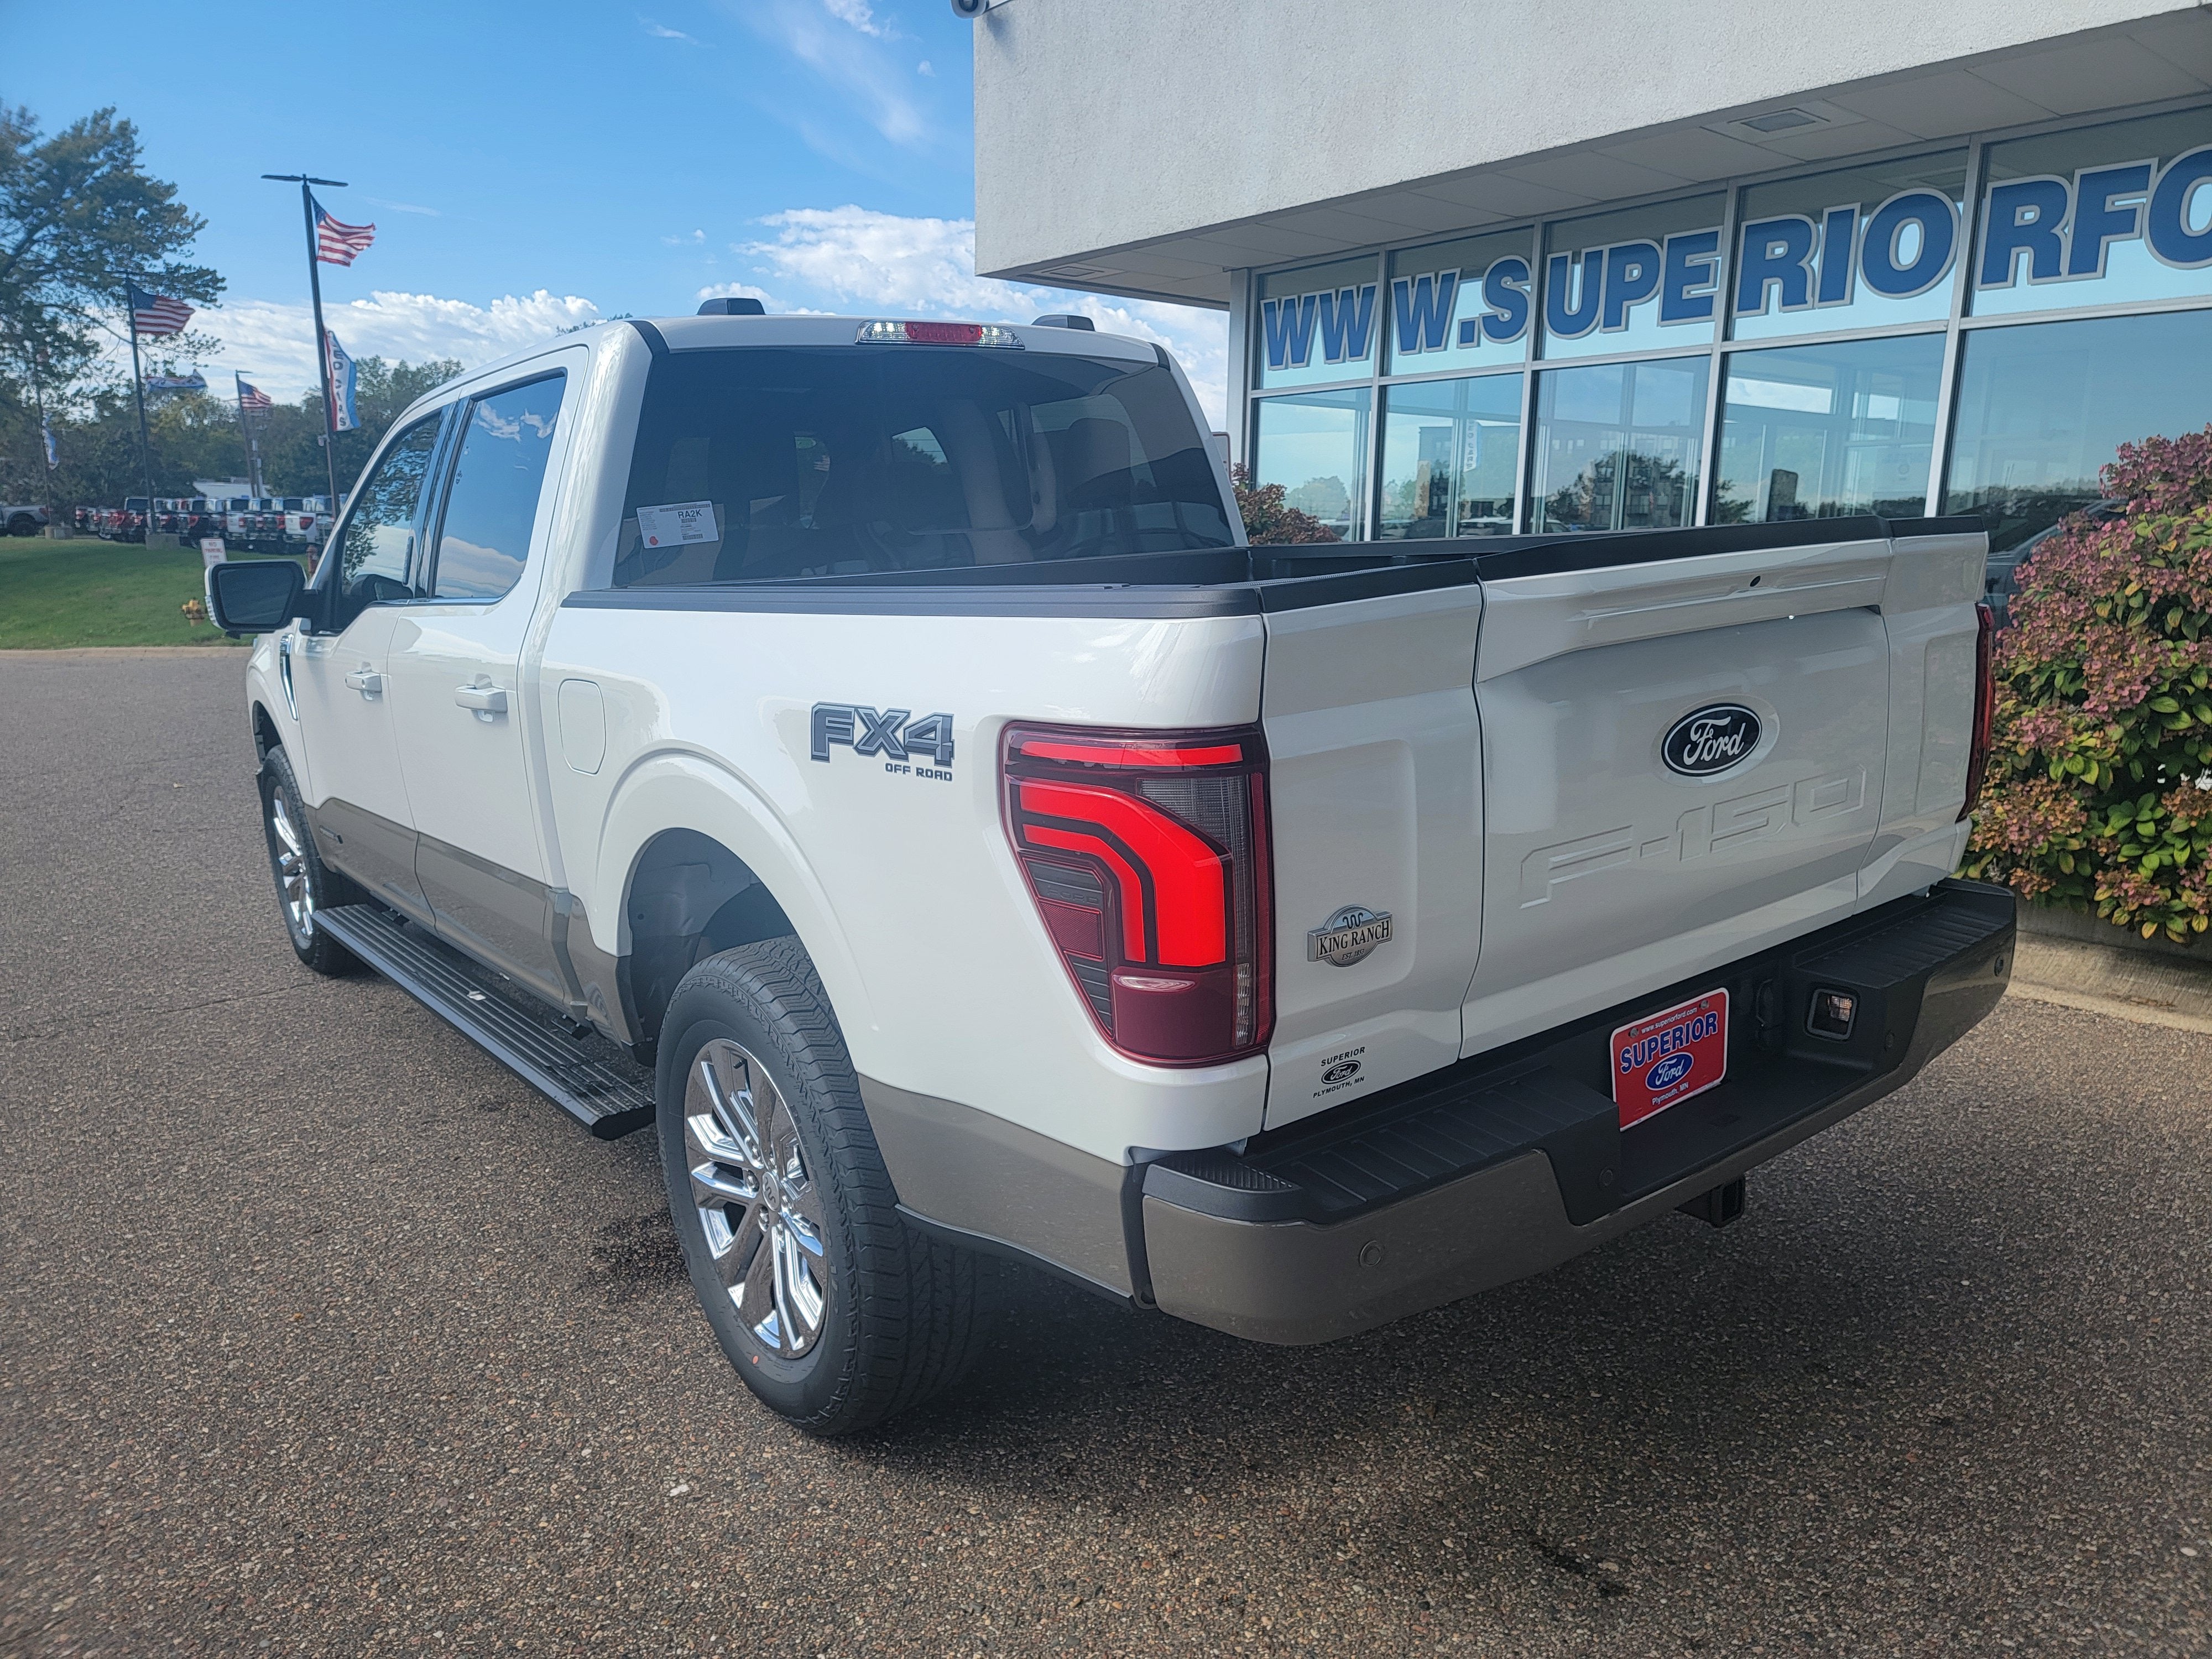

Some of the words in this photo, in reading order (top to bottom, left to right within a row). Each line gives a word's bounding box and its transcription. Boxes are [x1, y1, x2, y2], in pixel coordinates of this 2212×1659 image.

[677, 509, 702, 519] RA2K
[811, 701, 955, 769] FX4
[1683, 716, 1746, 765] Ford
[885, 763, 911, 775] OFF
[916, 766, 953, 781] ROAD
[1519, 765, 1867, 909] F-150
[1319, 933, 1349, 956] KING
[1351, 920, 1390, 947] RANCH
[1641, 1007, 1698, 1035] www.superiorford.com
[1620, 1010, 1718, 1074] SUPERIOR
[1321, 1046, 1365, 1067] SUPERIOR
[1330, 1063, 1353, 1079] Ford
[1655, 1058, 1686, 1086] Ford
[1313, 1080, 1353, 1099] PLYMOUTH,
[1354, 1076, 1365, 1084] MN
[1652, 1087, 1679, 1105] Plymouth,
[1679, 1082, 1689, 1092] MN
